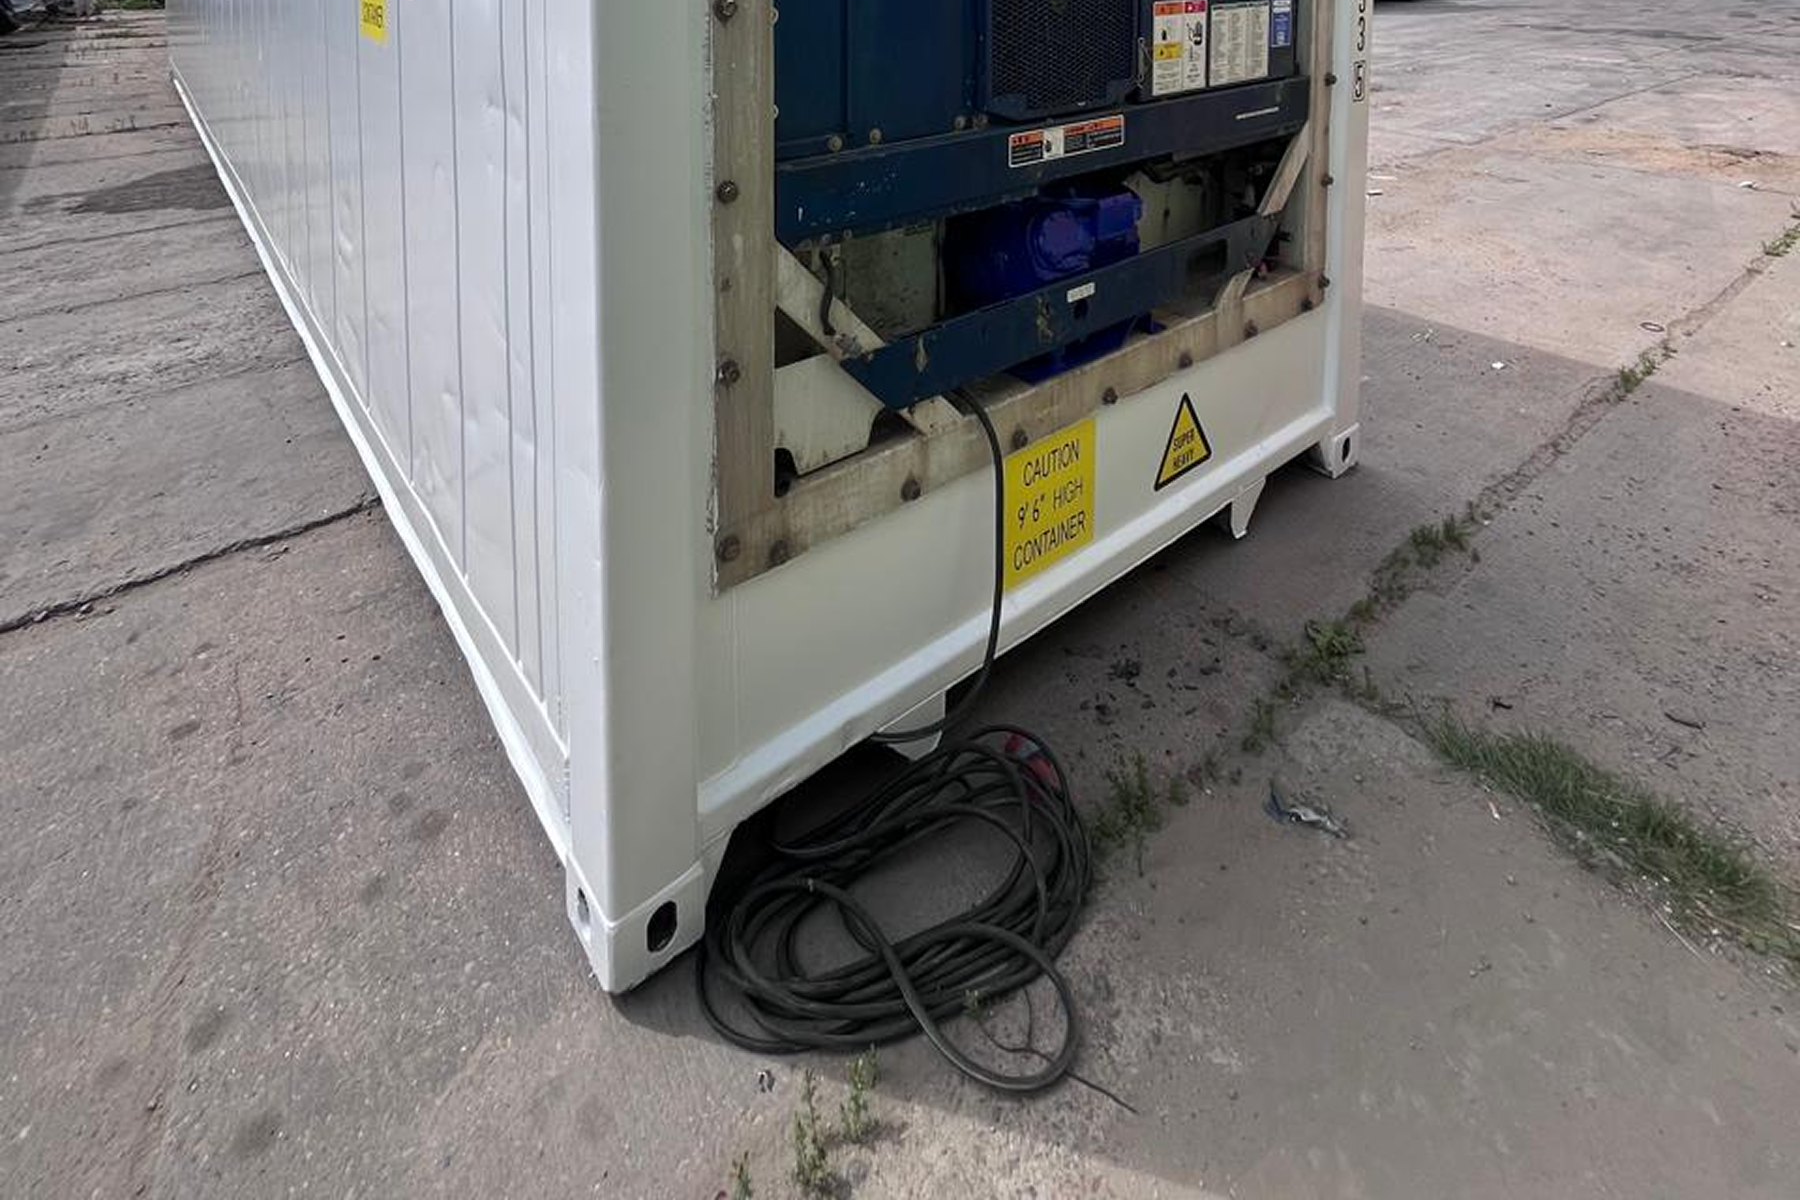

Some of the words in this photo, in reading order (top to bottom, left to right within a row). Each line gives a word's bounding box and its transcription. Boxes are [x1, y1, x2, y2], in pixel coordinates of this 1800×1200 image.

[1173, 427, 1195, 452] SUPER
[1022, 438, 1080, 487] CAUTION
[1053, 478, 1084, 510] HIGH
[1013, 510, 1087, 571] CONTAINER
